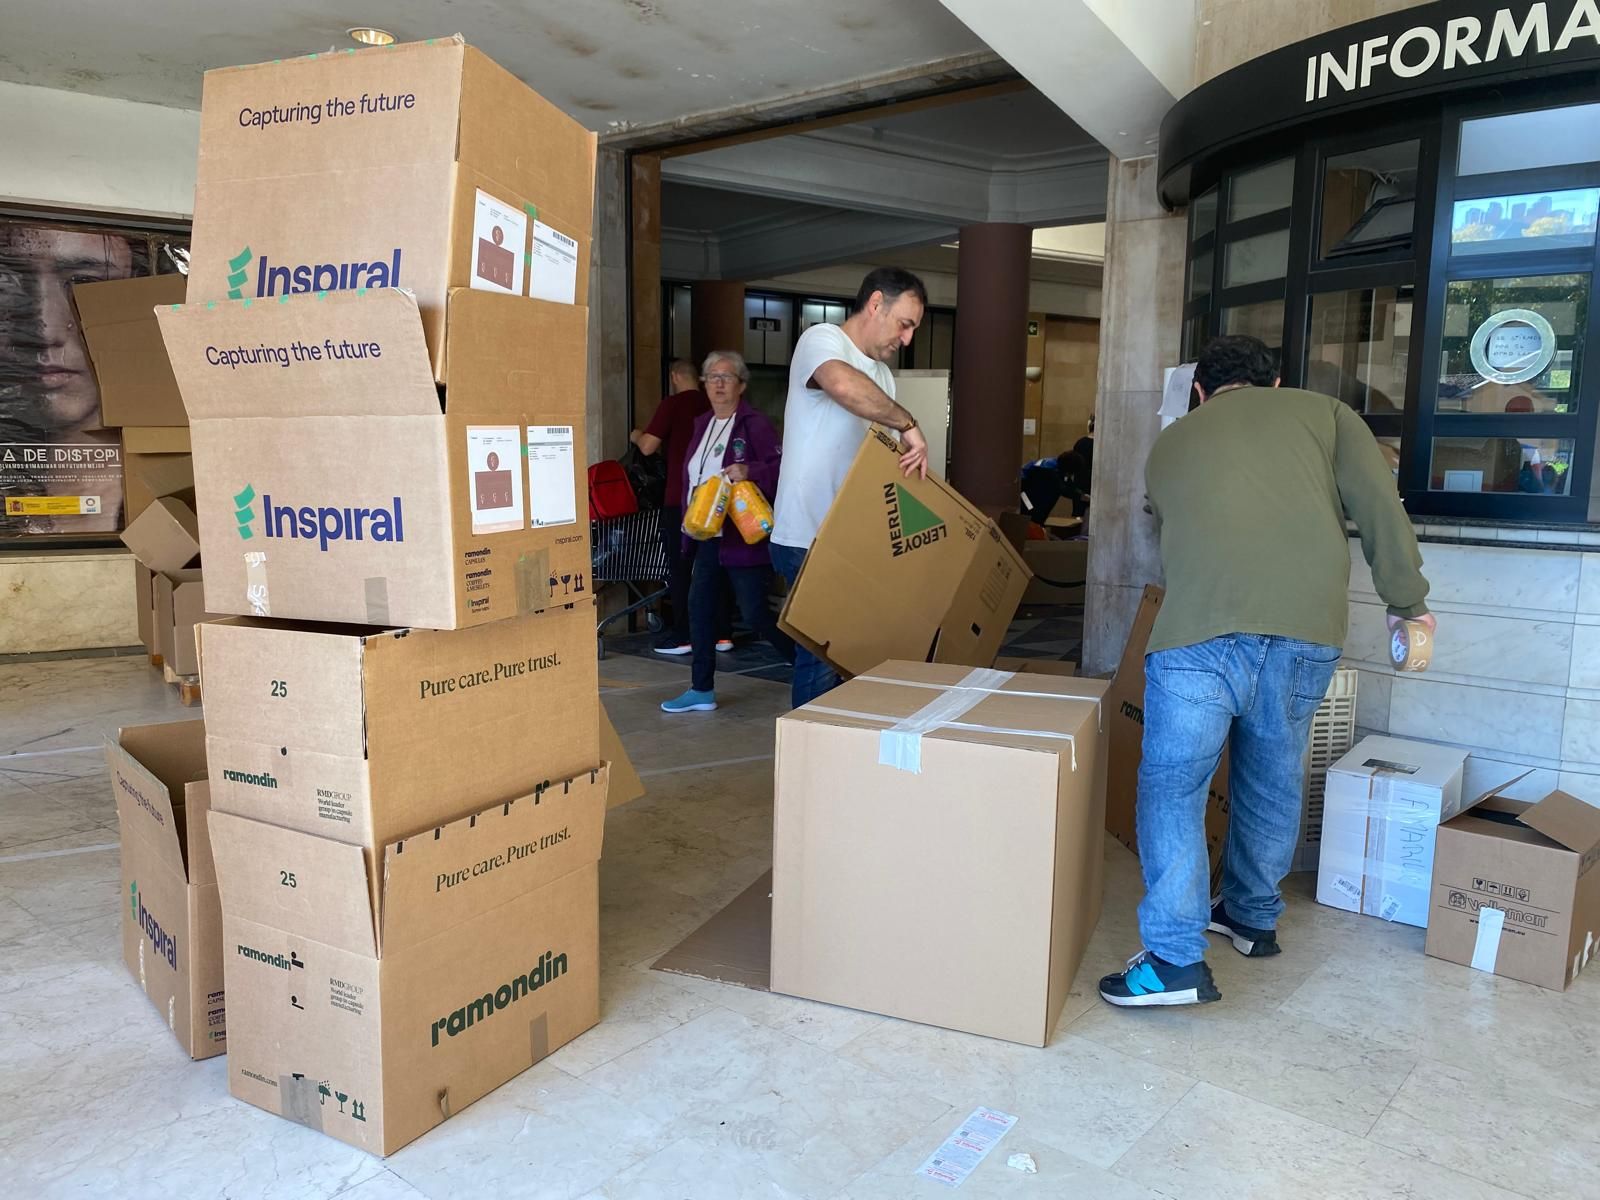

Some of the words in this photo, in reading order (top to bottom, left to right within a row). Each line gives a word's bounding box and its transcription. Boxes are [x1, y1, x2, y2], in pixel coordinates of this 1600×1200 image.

[1305, 0, 1600, 103] INFORMA
[239, 102, 322, 130] Capturing
[326, 97, 355, 117] the
[360, 93, 416, 114] future
[256, 248, 402, 298] Inspiral
[206, 343, 290, 370] Capturing
[291, 341, 322, 361] the
[324, 339, 382, 360] future
[23, 448, 48, 462] DE
[262, 494, 404, 552] Inspiral
[883, 481, 902, 558] MERLIN
[464, 547, 491, 558] ramondin
[902, 524, 948, 554] LEROY
[465, 568, 492, 579] ramondin
[270, 680, 288, 698] 25
[420, 677, 456, 699] Pure
[458, 669, 493, 689] care.
[494, 661, 525, 681] Pure
[528, 651, 561, 672] trust.
[223, 769, 278, 788] ramondin
[436, 868, 470, 893] Pure
[472, 854, 505, 877] care.
[506, 840, 537, 864] Pure
[540, 825, 571, 850] trust.
[280, 870, 297, 888] 25
[138, 891, 177, 972] Inspiral
[237, 944, 292, 971] ramondin
[431, 950, 567, 1048] ramondin
[241, 1068, 278, 1088] ramondin.com
